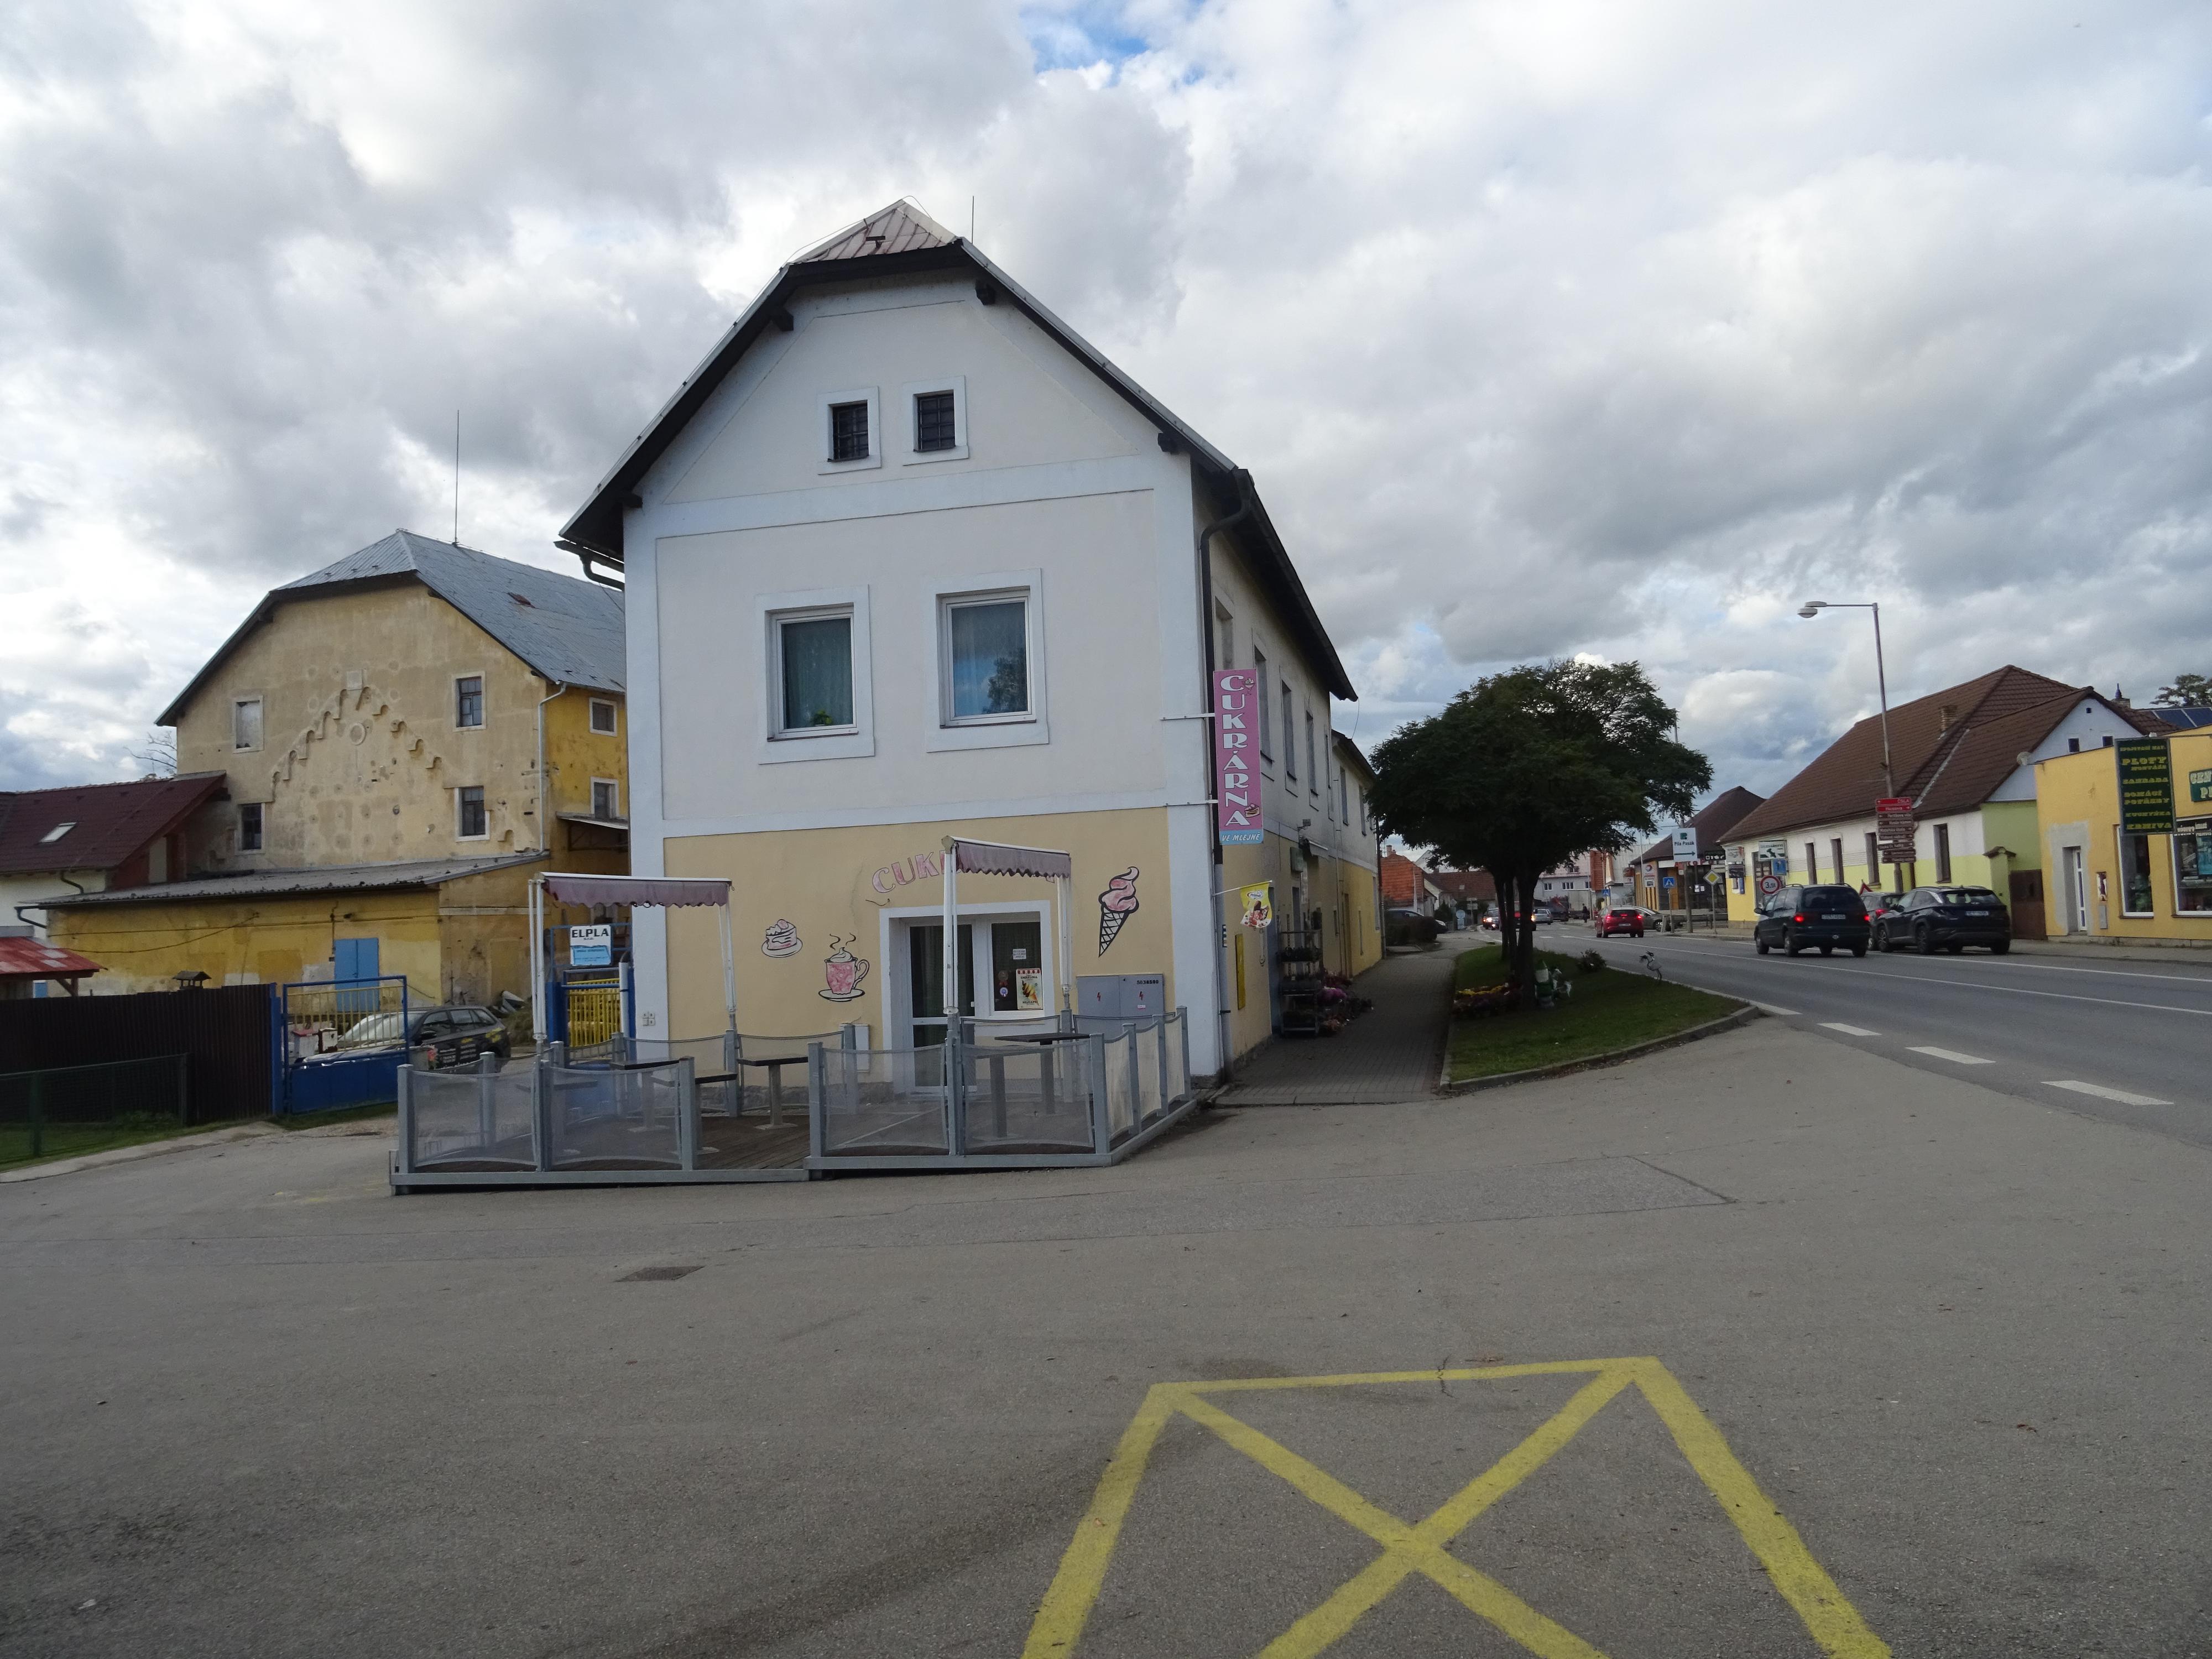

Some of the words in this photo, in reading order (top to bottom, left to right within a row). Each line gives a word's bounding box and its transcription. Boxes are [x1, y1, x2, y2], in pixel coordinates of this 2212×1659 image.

[1220, 675, 1251, 826] CUKRÁRNA
[2122, 757, 2167, 765] PLOTY
[1233, 832, 1260, 841] MLEJNĚ
[572, 928, 609, 938] ELPLA
